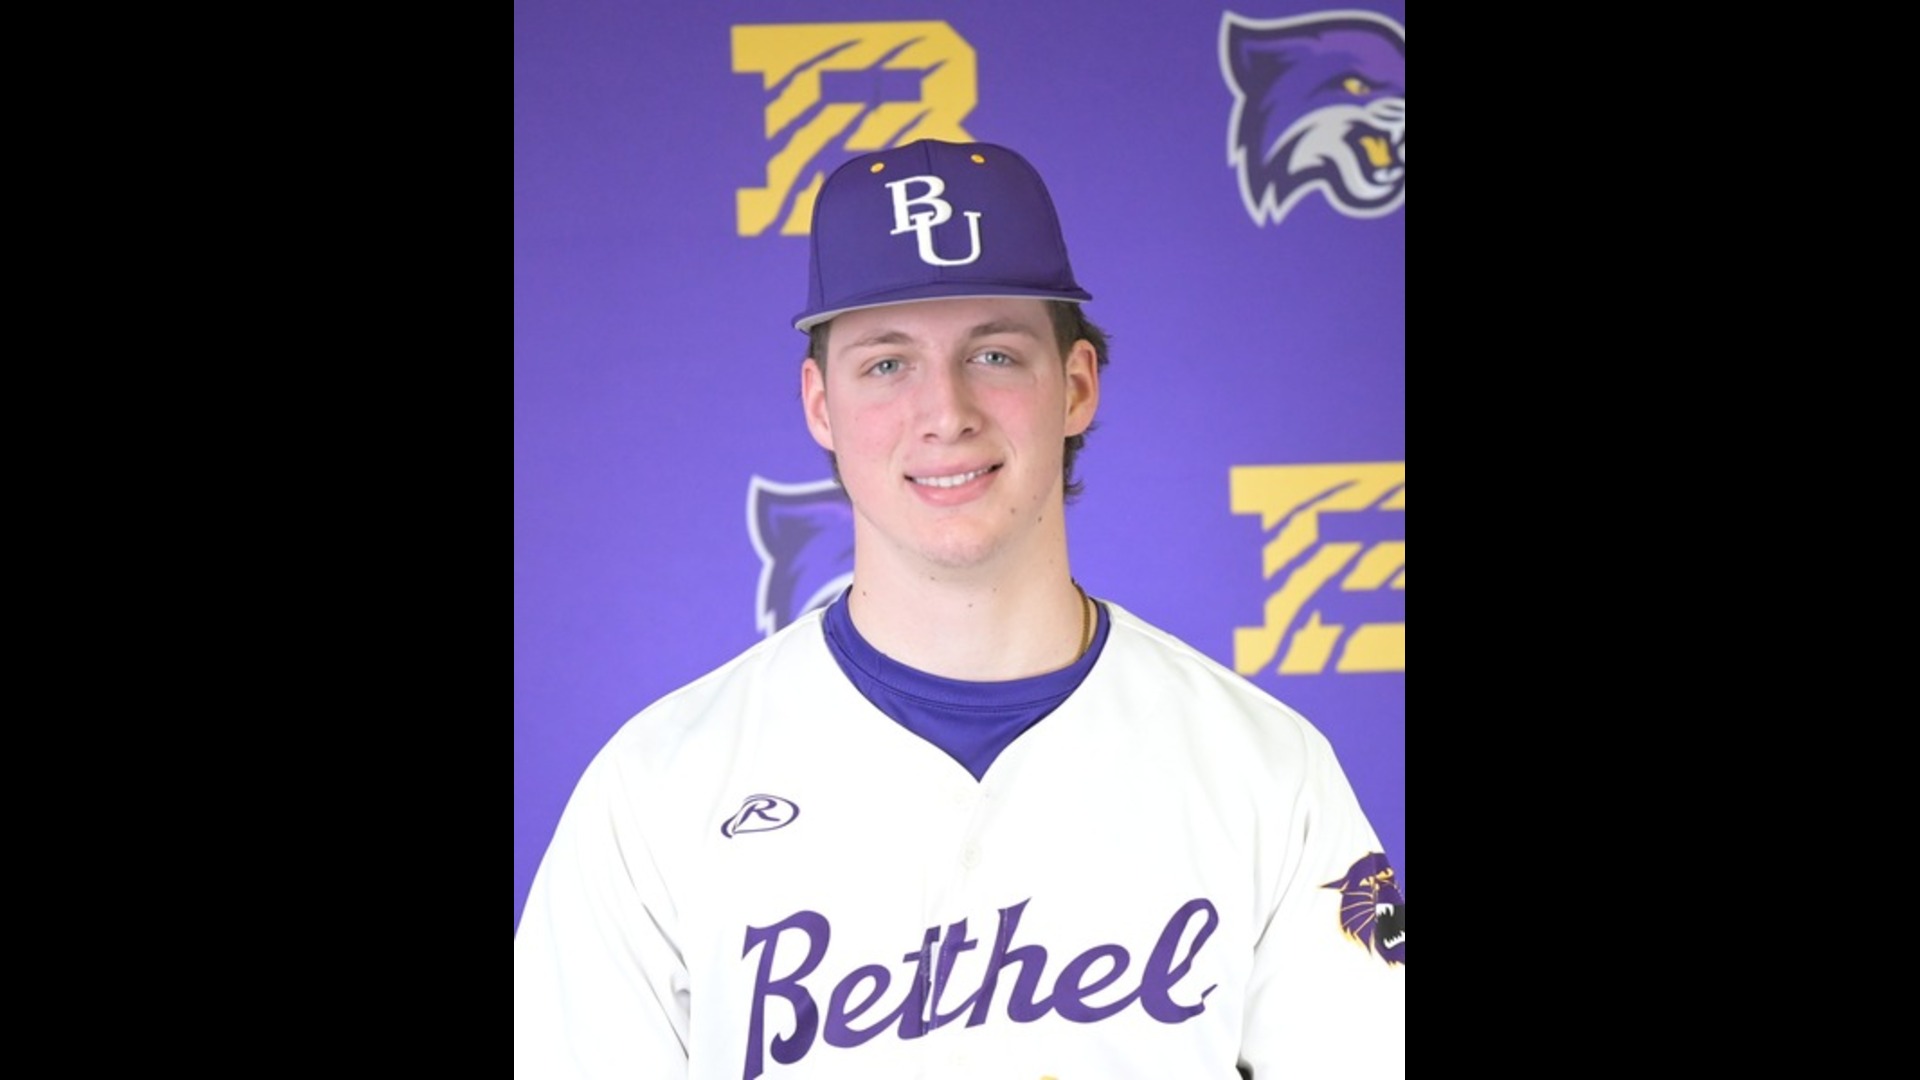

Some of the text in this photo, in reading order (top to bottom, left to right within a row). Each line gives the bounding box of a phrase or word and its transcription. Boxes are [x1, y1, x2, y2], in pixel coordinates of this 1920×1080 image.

[884, 174, 982, 267] BU
[721, 796, 782, 838] R
[741, 896, 1219, 1080] Bethel
